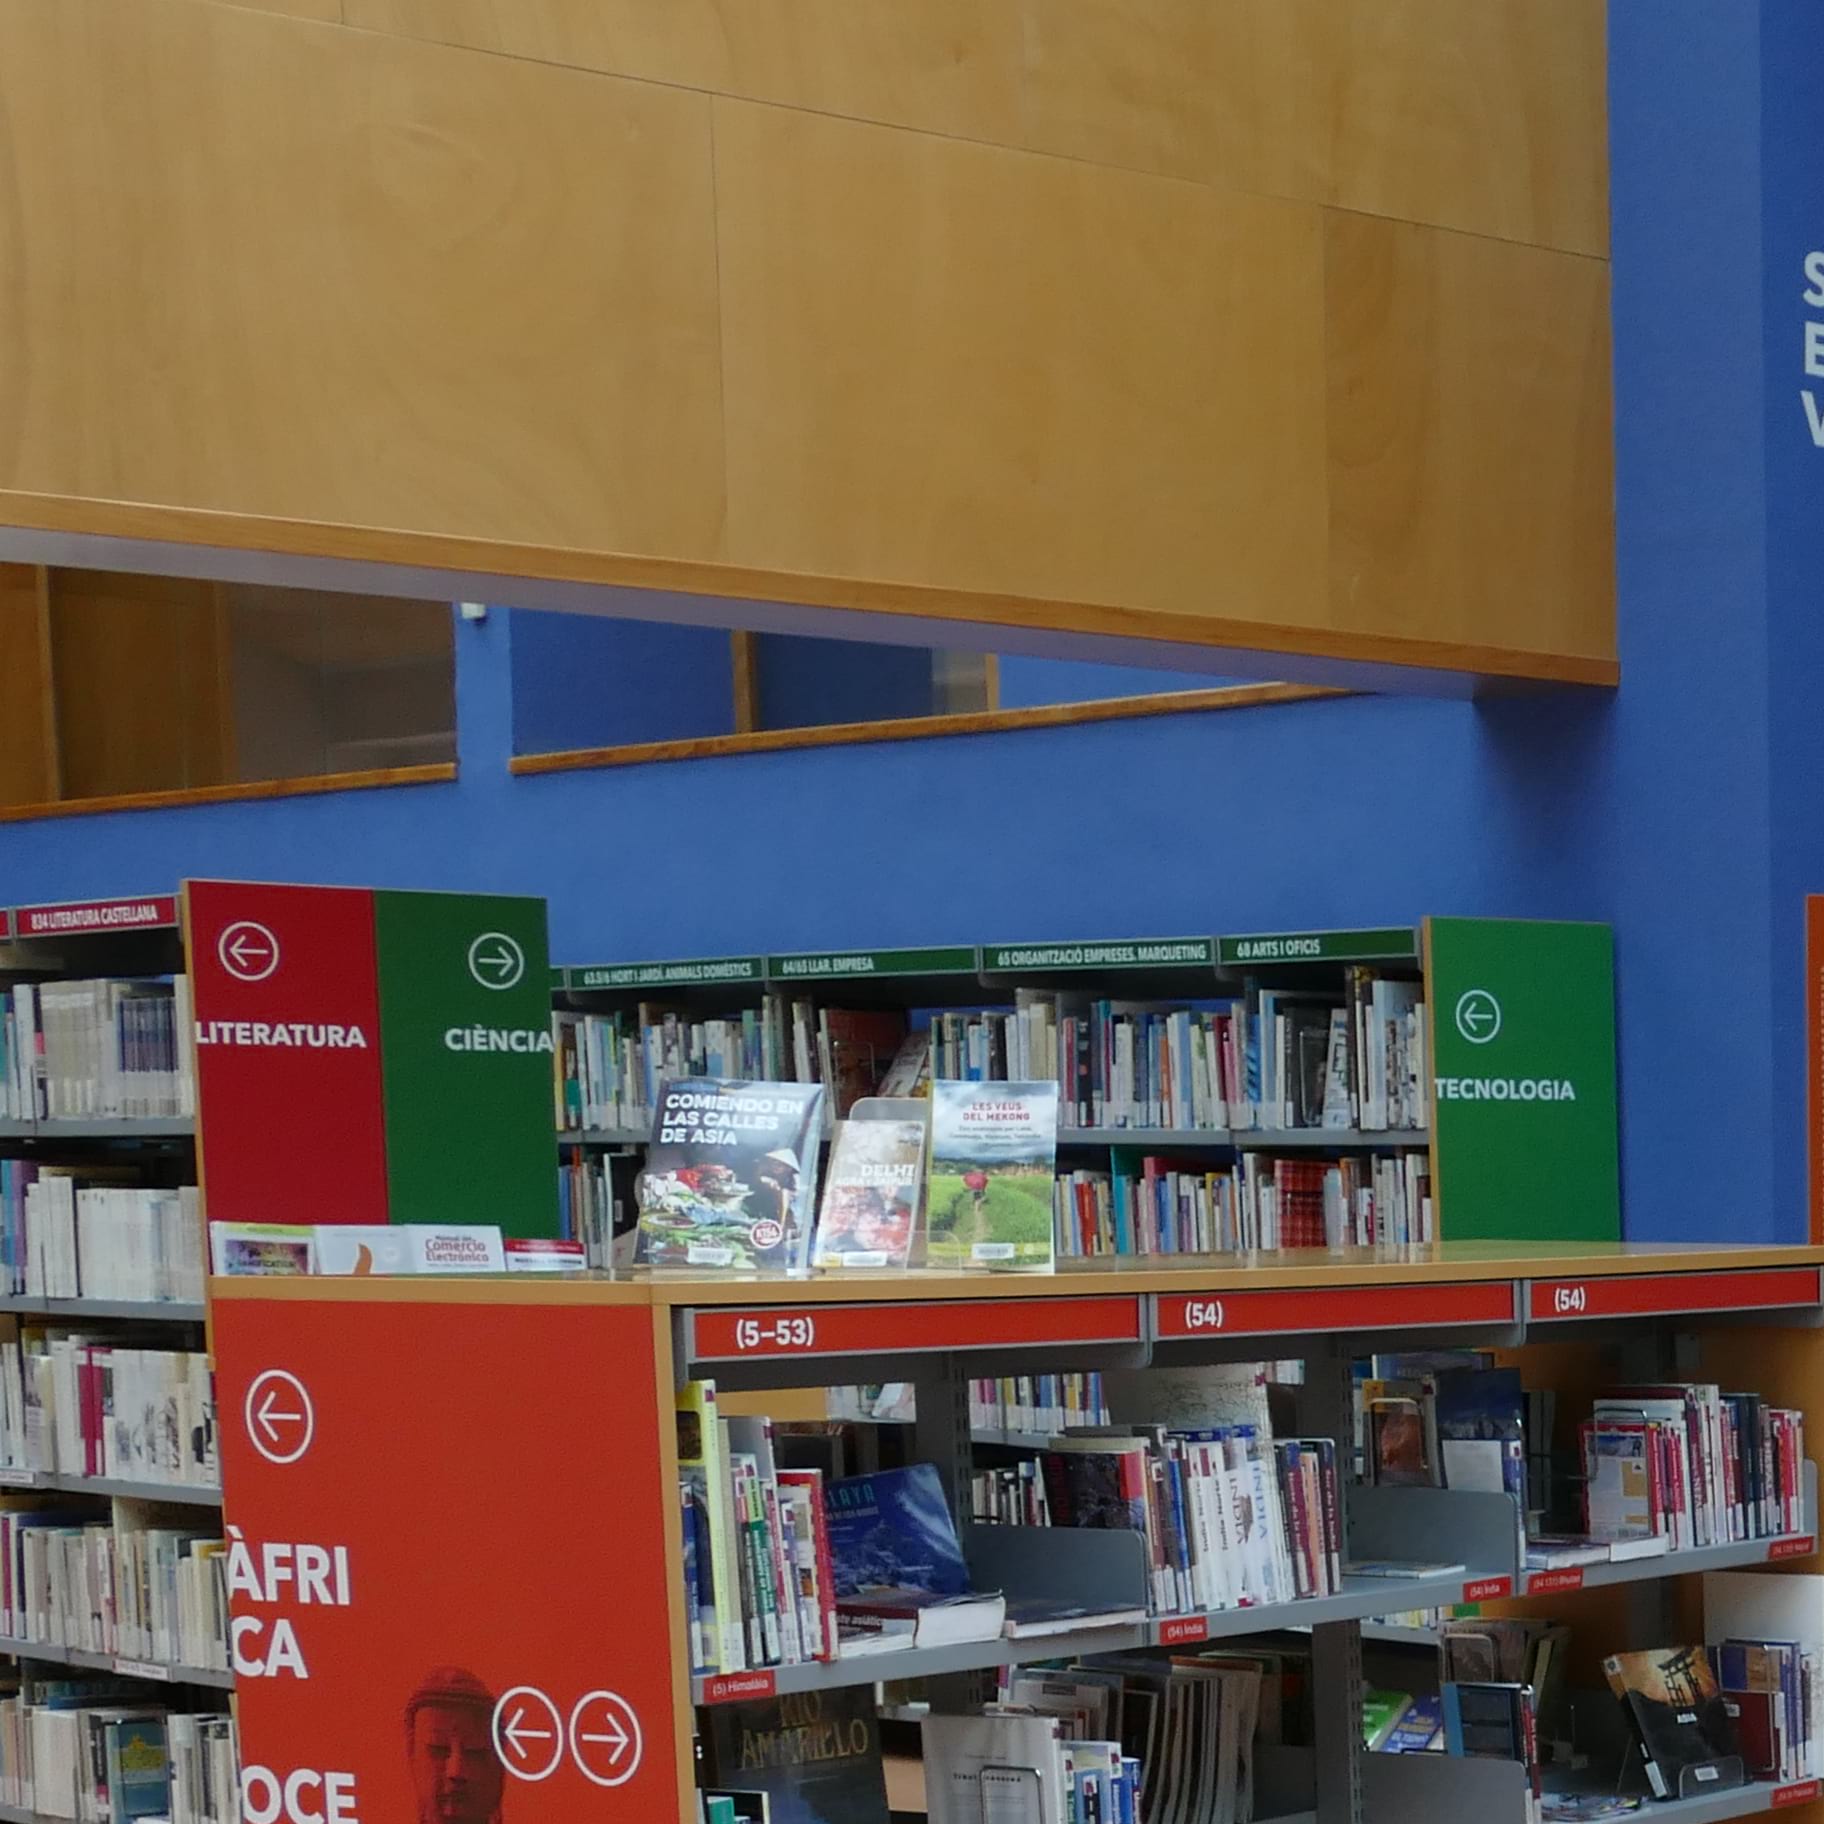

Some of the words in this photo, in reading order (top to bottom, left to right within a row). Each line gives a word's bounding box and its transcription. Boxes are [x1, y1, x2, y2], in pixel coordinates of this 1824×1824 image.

[50, 909, 100, 929] LITERATURA
[101, 904, 158, 925] CASTELLANA
[1138, 944, 1206, 962] MARQUETING
[1252, 940, 1278, 957] ARTS
[1285, 938, 1320, 955] OFICIS
[833, 955, 874, 973] EMPRESA
[194, 1020, 367, 1050] LITERATURA
[444, 1020, 555, 1054] CIÈNCIA
[1434, 1076, 1577, 1101] TECNOLOGIA
[665, 1093, 774, 1114] COMIENDO
[777, 1098, 804, 1116] EN
[661, 1110, 691, 1128] LAS
[693, 1112, 778, 1131] CALLES
[962, 1112, 984, 1122] DEL
[660, 1127, 688, 1144] DE
[690, 1128, 738, 1146] ASIA
[861, 1163, 916, 1178] DELHI
[1553, 1283, 1586, 1314] (54)
[1184, 1298, 1225, 1331] (54)
[226, 1524, 350, 1606] ÀFRI
[231, 1617, 309, 1680] CA
[711, 1679, 725, 1697] (5)
